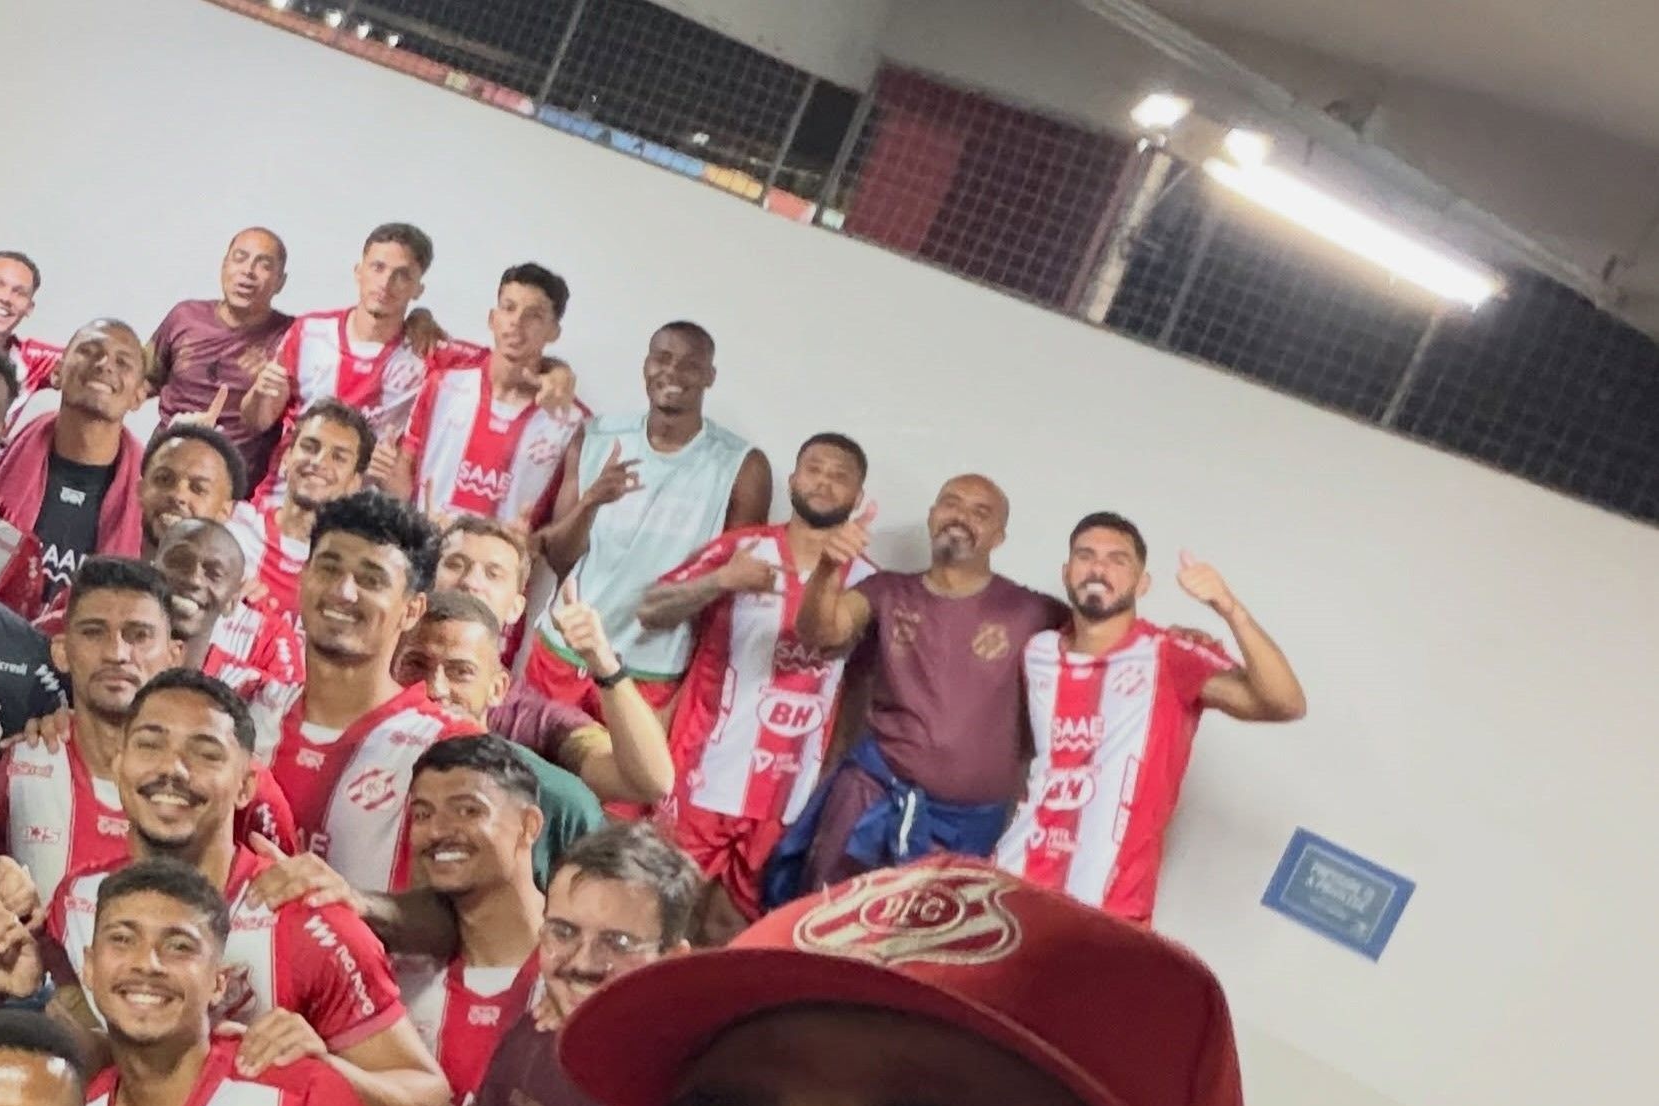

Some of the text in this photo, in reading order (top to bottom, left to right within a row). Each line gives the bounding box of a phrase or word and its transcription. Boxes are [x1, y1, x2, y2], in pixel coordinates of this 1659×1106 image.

[458, 461, 511, 490] SAAE
[39, 541, 89, 572] AA
[768, 703, 814, 727] BH
[1053, 715, 1104, 740] SAAE
